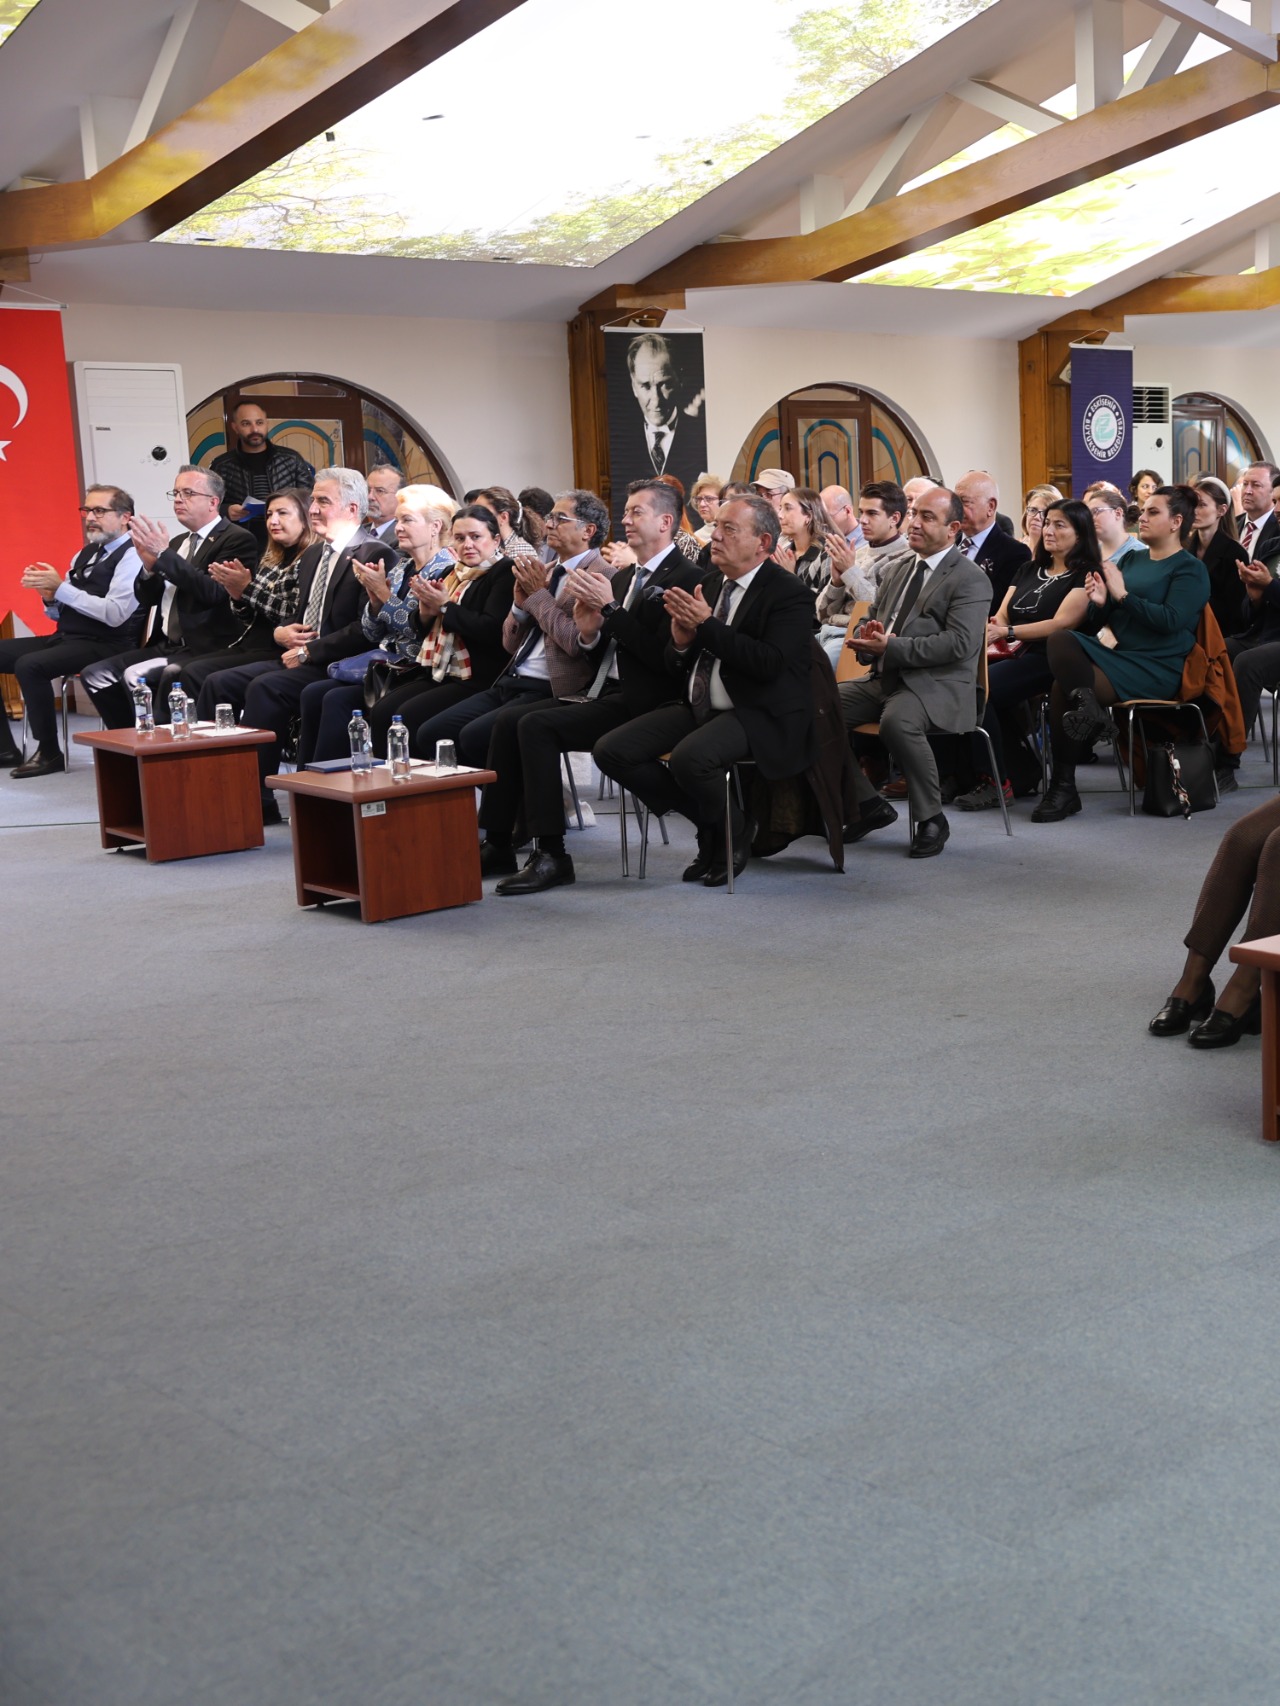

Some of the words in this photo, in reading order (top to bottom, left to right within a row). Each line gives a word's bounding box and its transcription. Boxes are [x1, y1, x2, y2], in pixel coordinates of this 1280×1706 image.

[1090, 397, 1117, 412] ESKİŞEHİR
[1084, 418, 1107, 459] BÜYÜKŞEHİR
[1107, 417, 1123, 458] BELEDİYESİ
